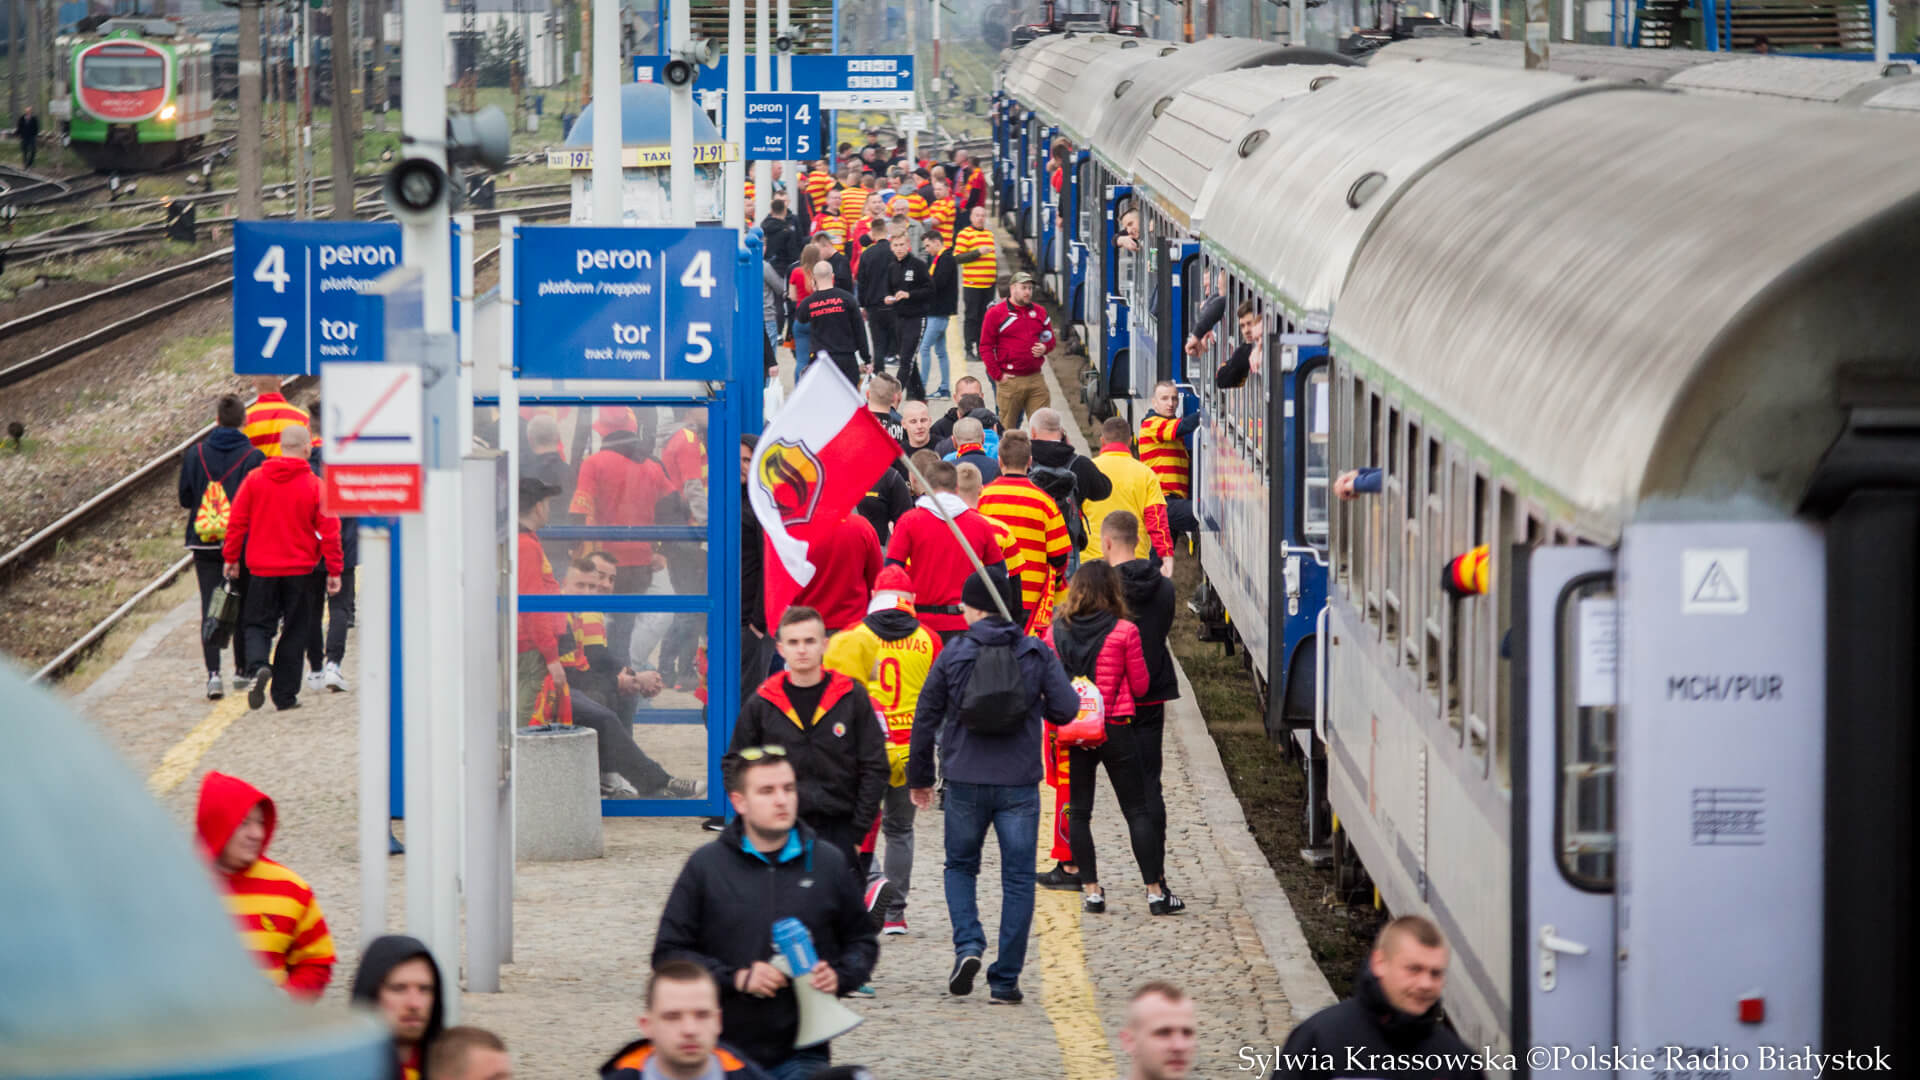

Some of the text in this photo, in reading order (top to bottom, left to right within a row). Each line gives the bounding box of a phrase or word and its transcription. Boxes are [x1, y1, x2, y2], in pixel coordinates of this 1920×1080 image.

[749, 103, 783, 115] peron
[794, 103, 811, 125] 4
[764, 135, 783, 145] tor
[796, 135, 810, 154] 5
[253, 244, 396, 294] 4 peron
[576, 249, 717, 299] peron 4
[537, 278, 595, 297] platform
[257, 316, 359, 359] 7 tor
[584, 347, 614, 361] track
[611, 321, 713, 365] tor 5
[880, 657, 901, 712] 9
[1667, 675, 1785, 701] MCH/PUR
